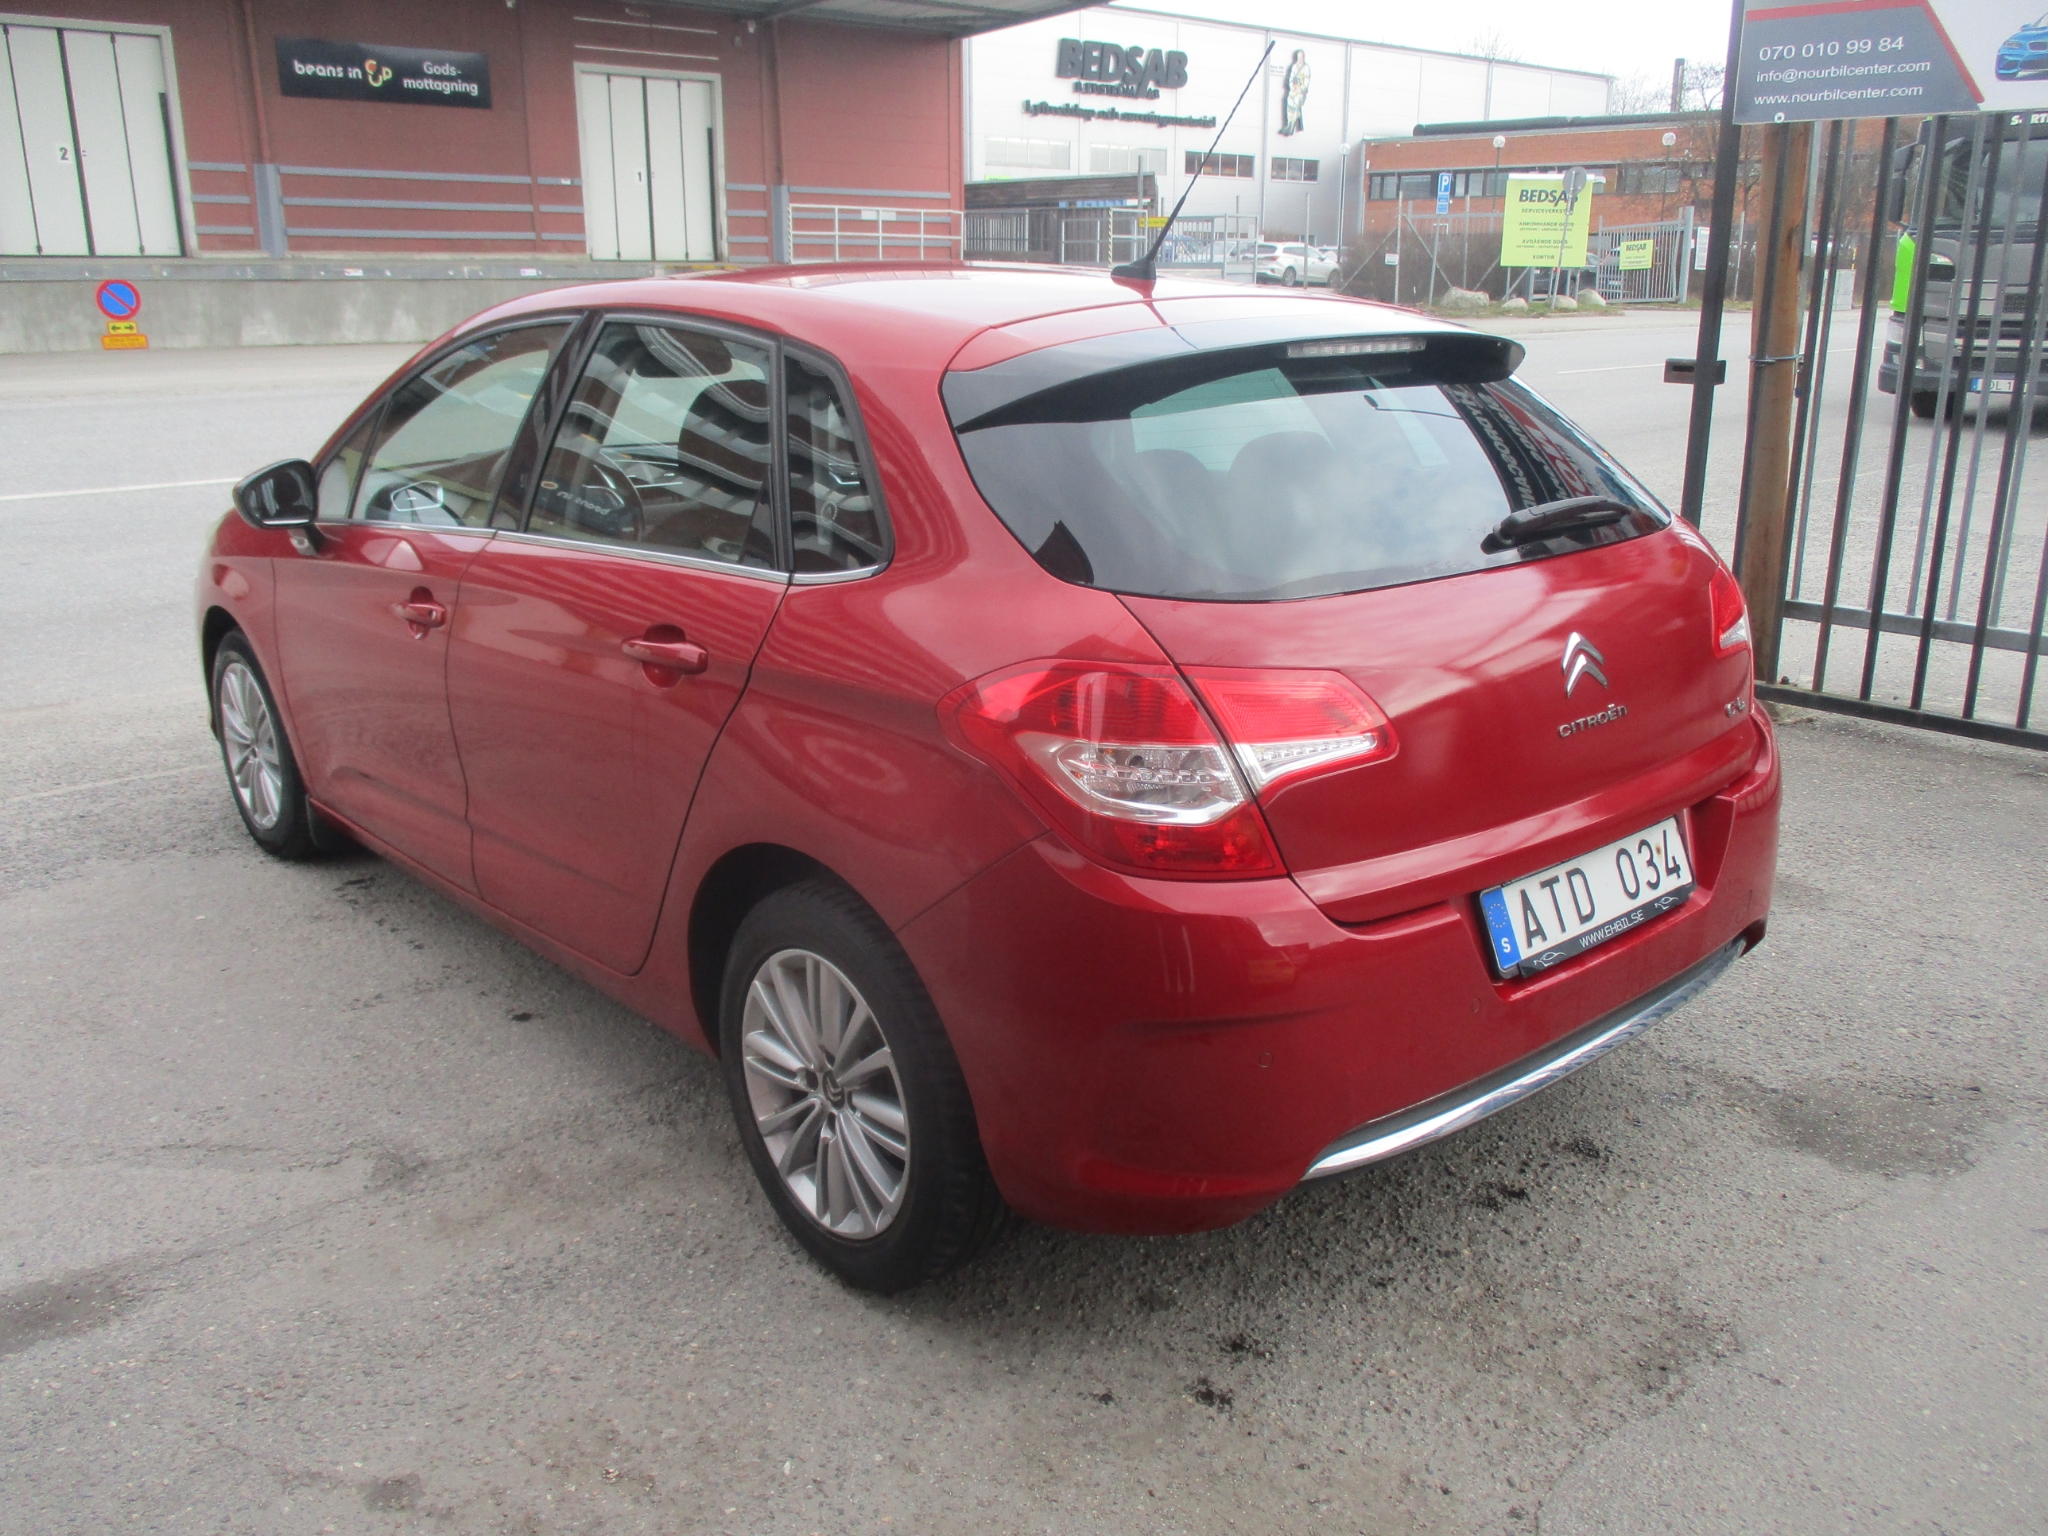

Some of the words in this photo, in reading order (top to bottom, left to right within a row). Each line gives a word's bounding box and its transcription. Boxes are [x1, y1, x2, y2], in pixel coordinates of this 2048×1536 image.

[1759, 45, 1796, 61] 070
[1801, 41, 1840, 58] 010
[1846, 39, 1872, 55] 99
[1878, 36, 1905, 52] 84
[293, 59, 344, 78] beans
[348, 66, 363, 80] in
[423, 61, 462, 76] Gods-
[1056, 38, 1188, 99] BEDSAB
[1756, 61, 1931, 83] info@nourbilcenter.com
[403, 77, 479, 97] mottagning
[1754, 86, 1923, 105] www.nourbilcenter.com
[59, 146, 69, 161] 2
[1519, 866, 1596, 949] ATD
[1615, 829, 1682, 900] 034
[1501, 937, 1511, 953] S
